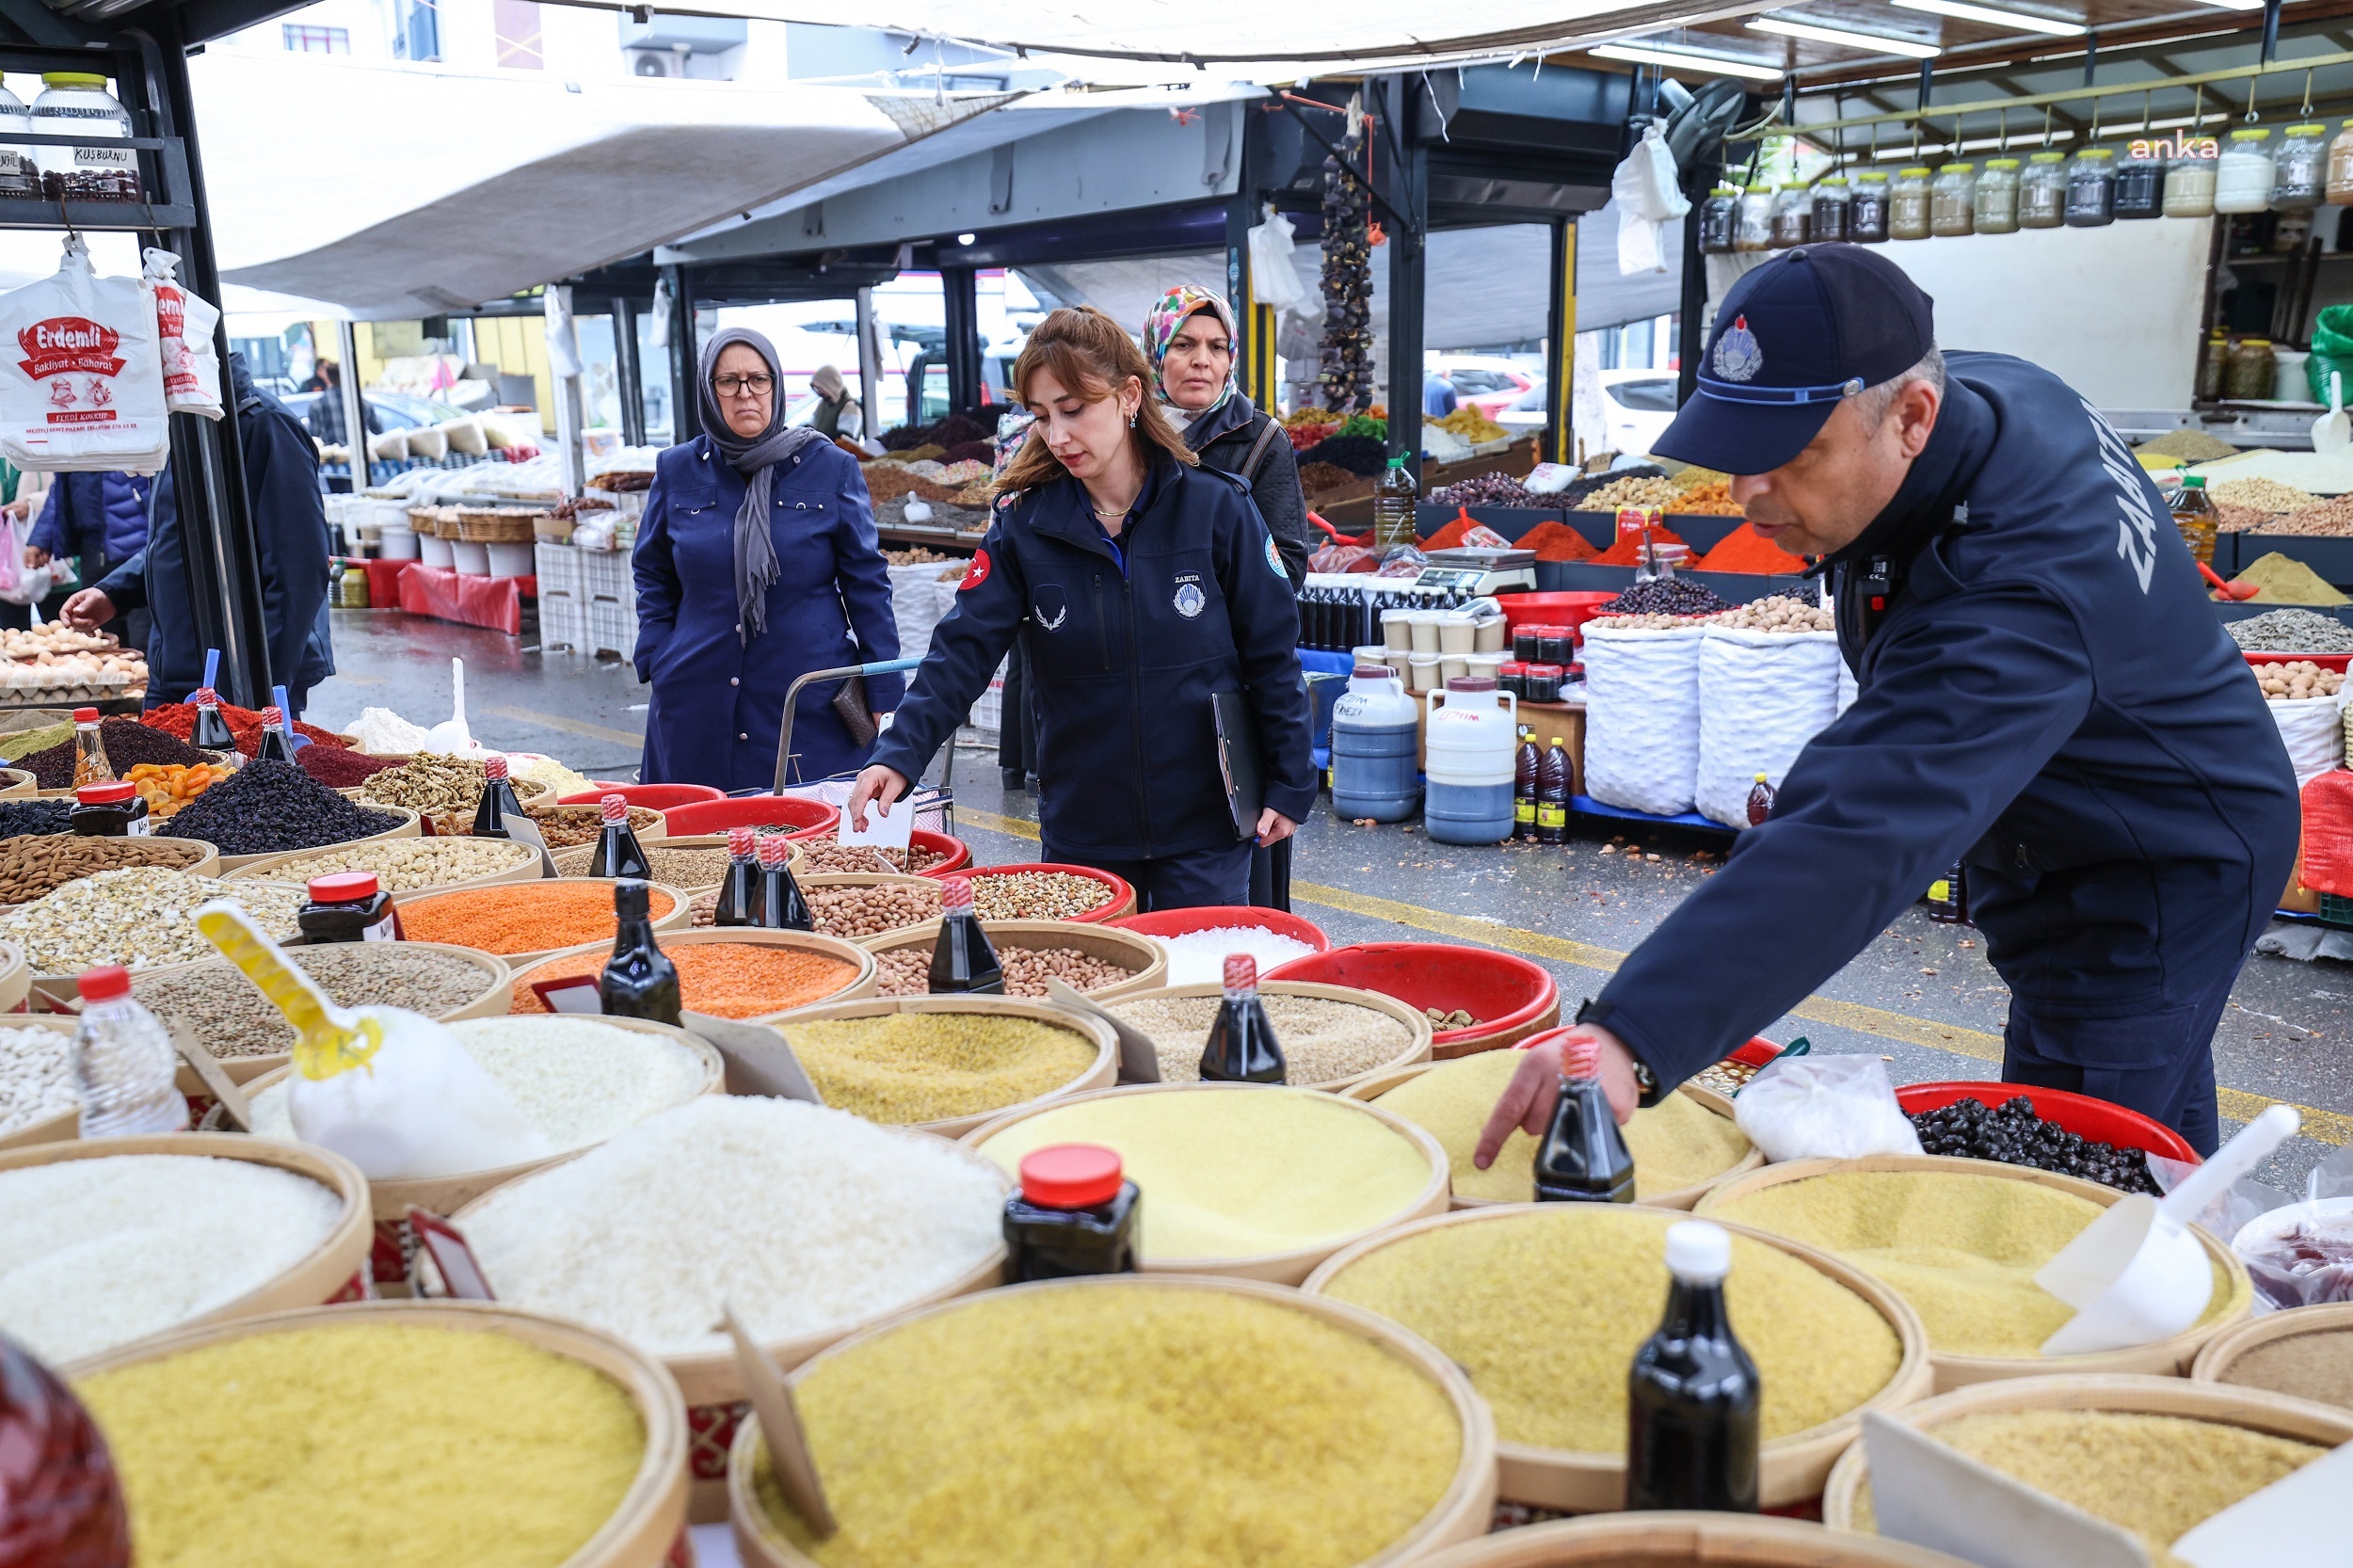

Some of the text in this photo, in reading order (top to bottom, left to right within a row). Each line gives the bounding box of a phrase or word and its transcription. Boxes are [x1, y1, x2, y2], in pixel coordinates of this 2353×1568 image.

[37, 324, 101, 349] Erdemli
[34, 358, 114, 375] Bakliyat Baharat
[1175, 574, 1201, 584] ZABITA
